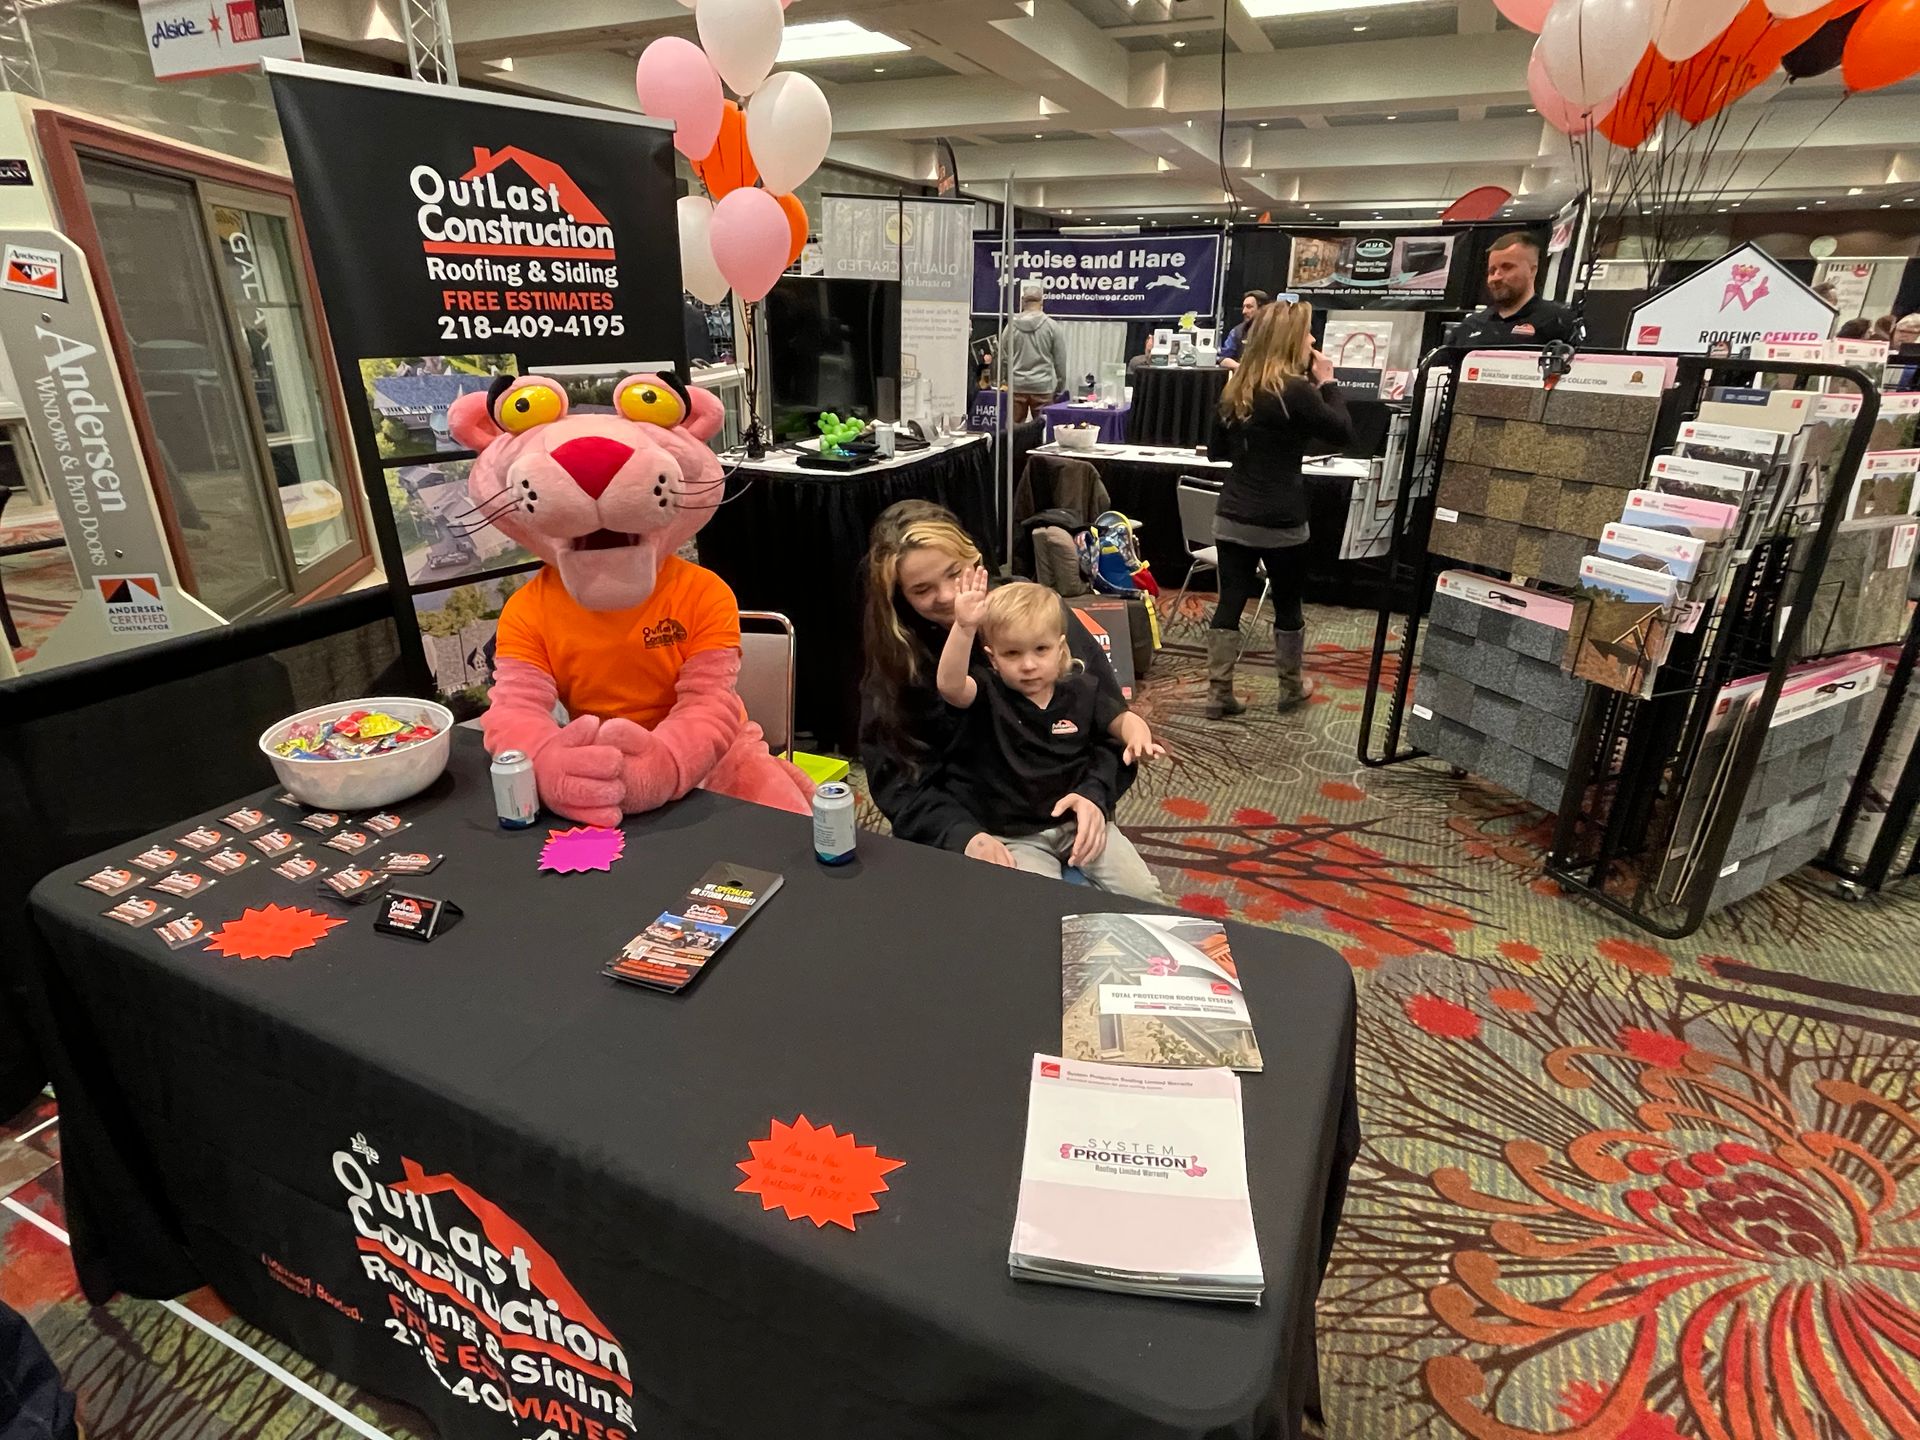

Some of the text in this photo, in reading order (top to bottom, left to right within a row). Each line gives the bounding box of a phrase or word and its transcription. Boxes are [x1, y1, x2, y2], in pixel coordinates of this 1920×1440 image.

[152, 17, 203, 48] Alside
[410, 165, 559, 212] OutLast
[418, 205, 614, 249] Construction
[1081, 251, 1123, 269] and
[1129, 250, 1186, 268] Hare
[426, 257, 618, 288] Roofing & Siding
[443, 291, 613, 311] FREE ESTIMATES
[437, 316, 625, 339] 218-409-4195
[1699, 331, 1762, 344] ROOFING
[1568, 378, 1607, 386] COLLECTION
[34, 325, 127, 513] Andersen
[34, 375, 108, 566] WINDOWS & PATIO DOORS
[108, 605, 164, 614] ANDERSEN
[110, 614, 168, 625] CERTIFIED
[113, 624, 169, 632] CONTRACTOR
[700, 889, 724, 900] STORM
[1088, 1138, 1174, 1155] SYSTEM
[1074, 1148, 1187, 1169] PROTECTION
[1095, 1164, 1169, 1179] Roofing Limited Warranty
[332, 1150, 532, 1290] OutLast
[347, 1195, 632, 1381] Construction
[360, 1255, 481, 1348] Roofing
[511, 1354, 638, 1433] Siding
